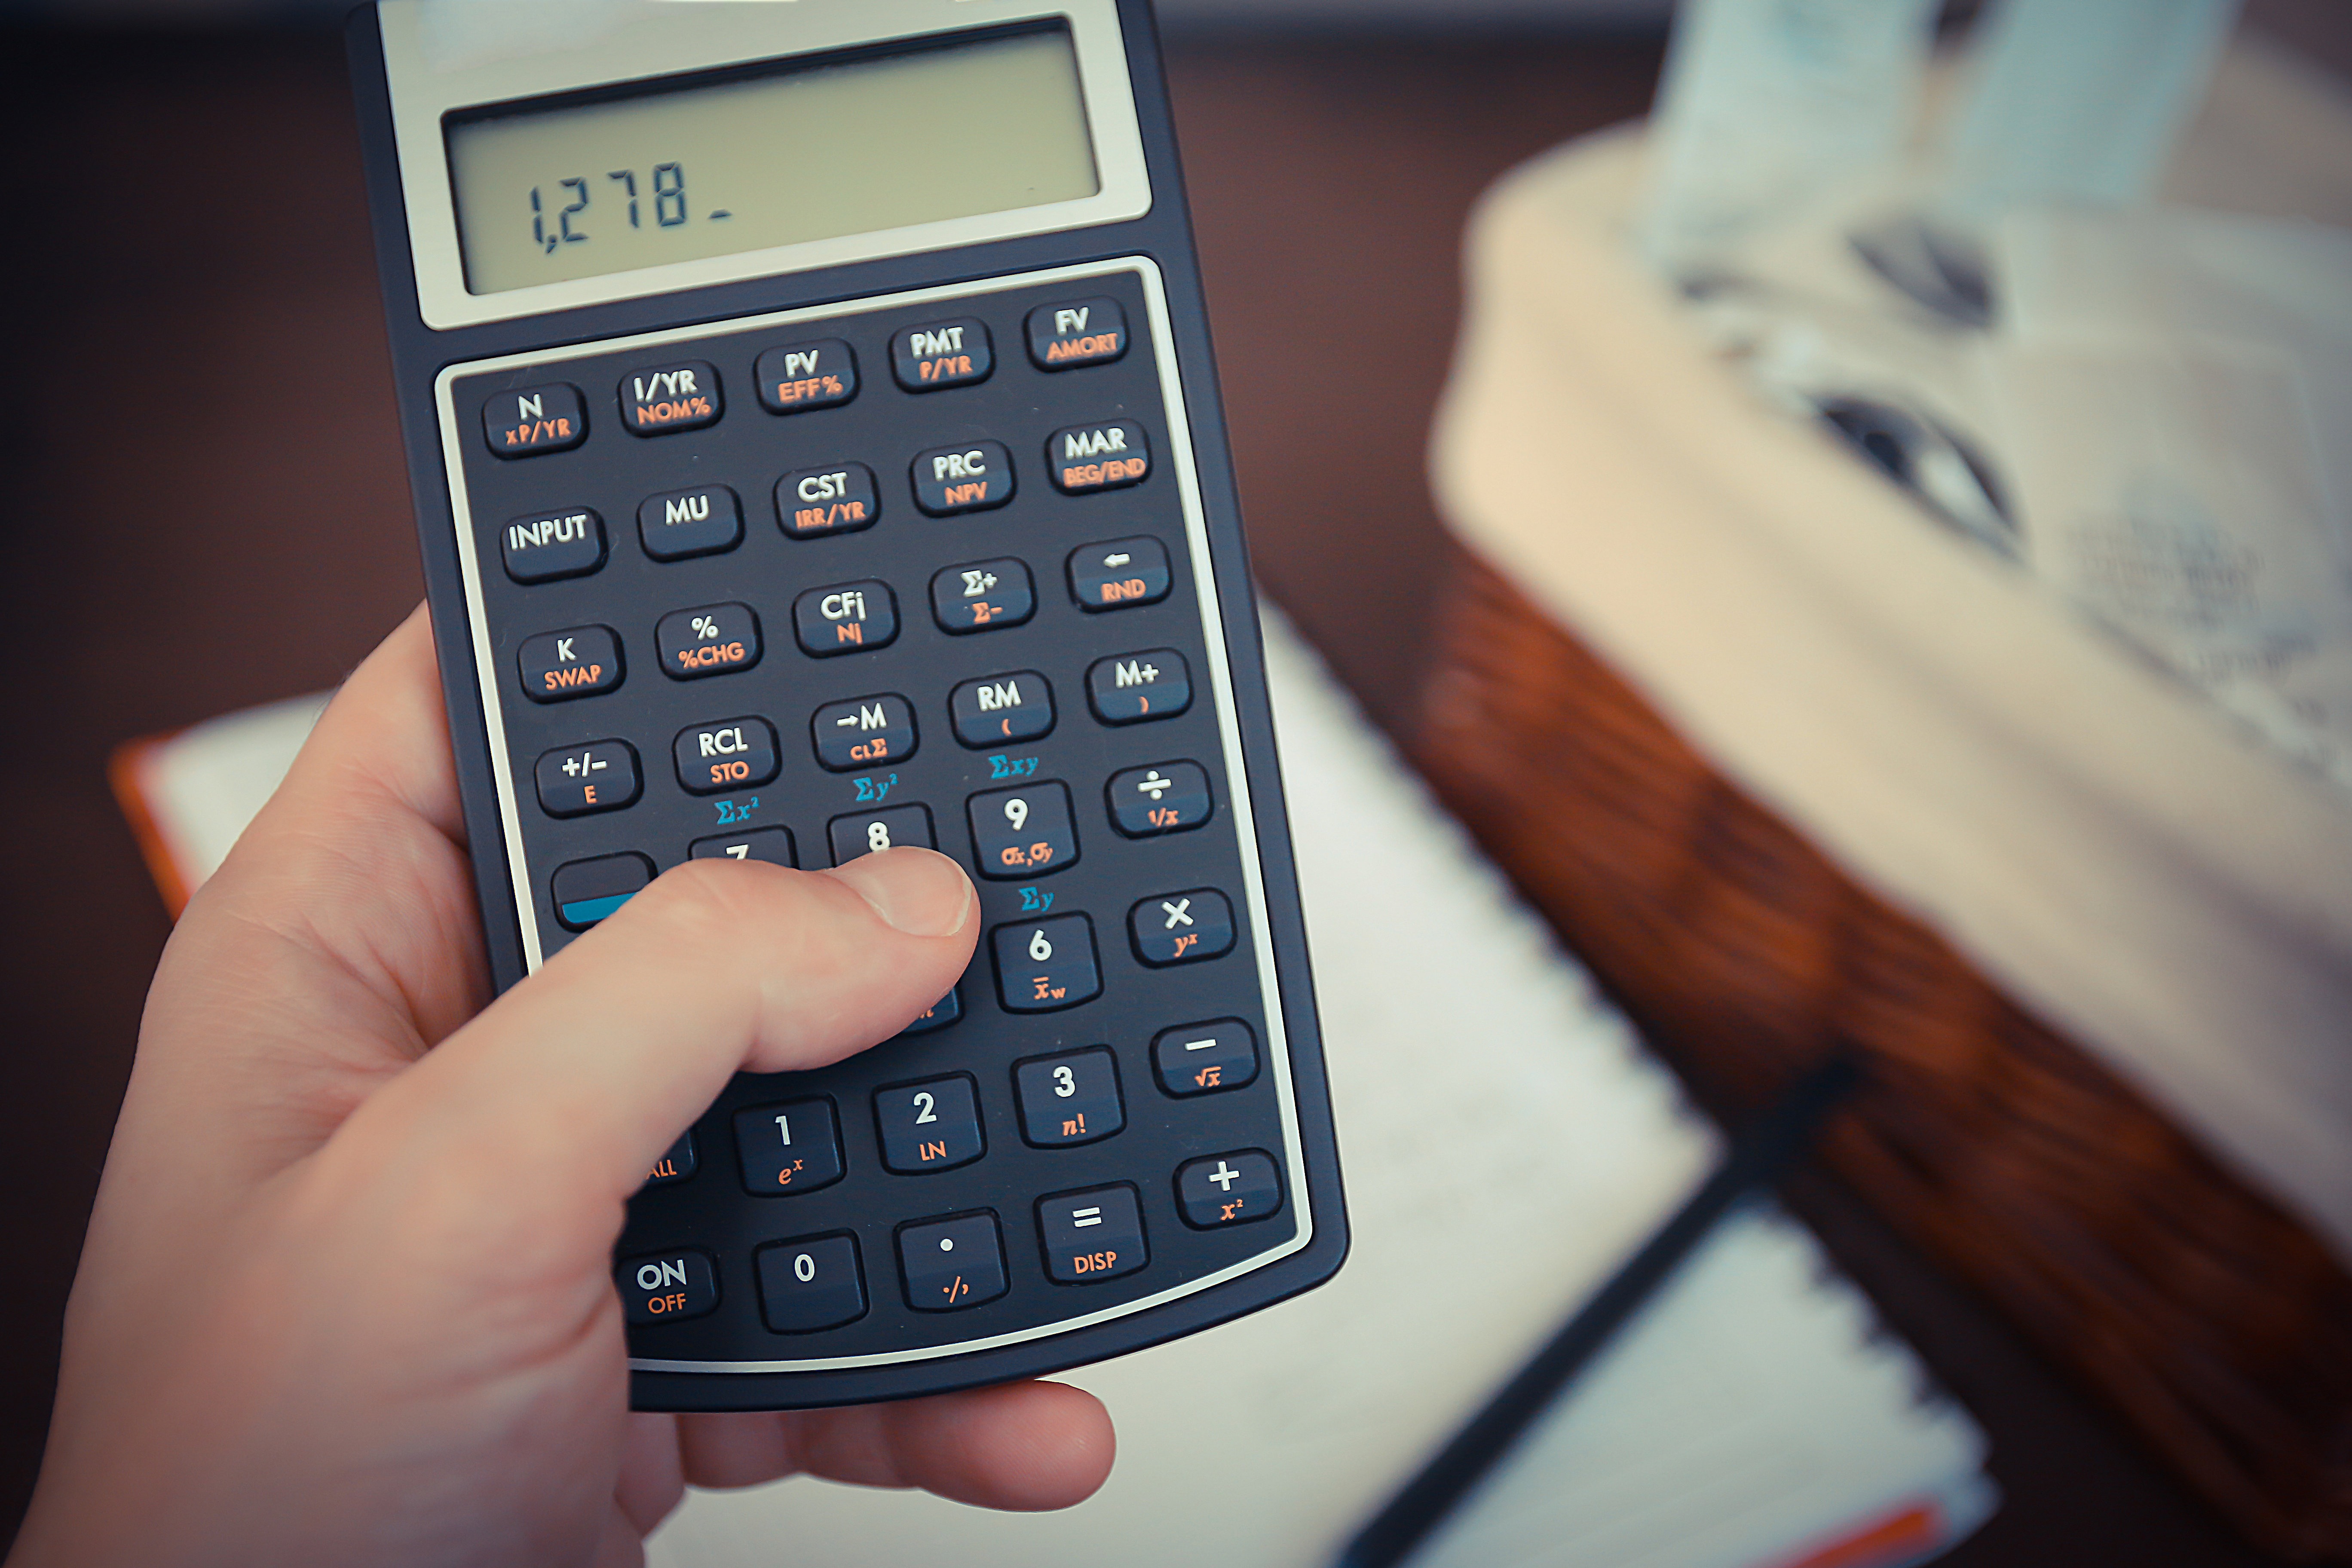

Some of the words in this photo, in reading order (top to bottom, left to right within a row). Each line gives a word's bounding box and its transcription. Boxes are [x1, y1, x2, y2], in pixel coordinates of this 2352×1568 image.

[1054, 307, 1089, 335] FV
[910, 327, 964, 358] PMT
[1047, 333, 1117, 359] AMORT
[785, 349, 819, 378] PV
[920, 355, 972, 380] P/YR
[634, 370, 698, 402] I/YR
[778, 375, 843, 402] EFF%
[518, 394, 543, 419] N
[637, 397, 711, 424] NOM%
[506, 418, 570, 444] xP/YR
[1065, 428, 1127, 460] MAR
[933, 450, 986, 481] PRC
[1064, 458, 1145, 487] BEG/END
[797, 472, 847, 502] CST
[945, 481, 987, 504] NPV
[665, 495, 709, 526] MU
[795, 501, 865, 528] IRR/YR
[509, 514, 587, 550] INPUT
[1102, 579, 1146, 601] RND
[691, 616, 718, 640] %
[557, 638, 576, 662] K
[678, 642, 745, 668] %CHG
[544, 665, 602, 690] SWAP
[1115, 660, 1159, 688] M+
[977, 680, 1022, 712] RM
[698, 727, 749, 757] RCL
[710, 761, 750, 783] STO
[584, 785, 597, 804] E
[1004, 799, 1028, 830] 9
[867, 822, 891, 852] 8
[1029, 930, 1052, 961] 6
[1053, 1066, 1075, 1097] 3
[913, 1092, 937, 1124] 2
[775, 1115, 790, 1145] 1
[919, 1141, 946, 1161] LN
[1209, 1161, 1240, 1191] +
[1072, 1207, 1102, 1227] =
[637, 1259, 686, 1290] ON
[794, 1254, 815, 1282] 0
[1074, 1251, 1117, 1274] DISP
[648, 1293, 686, 1314] OFF
